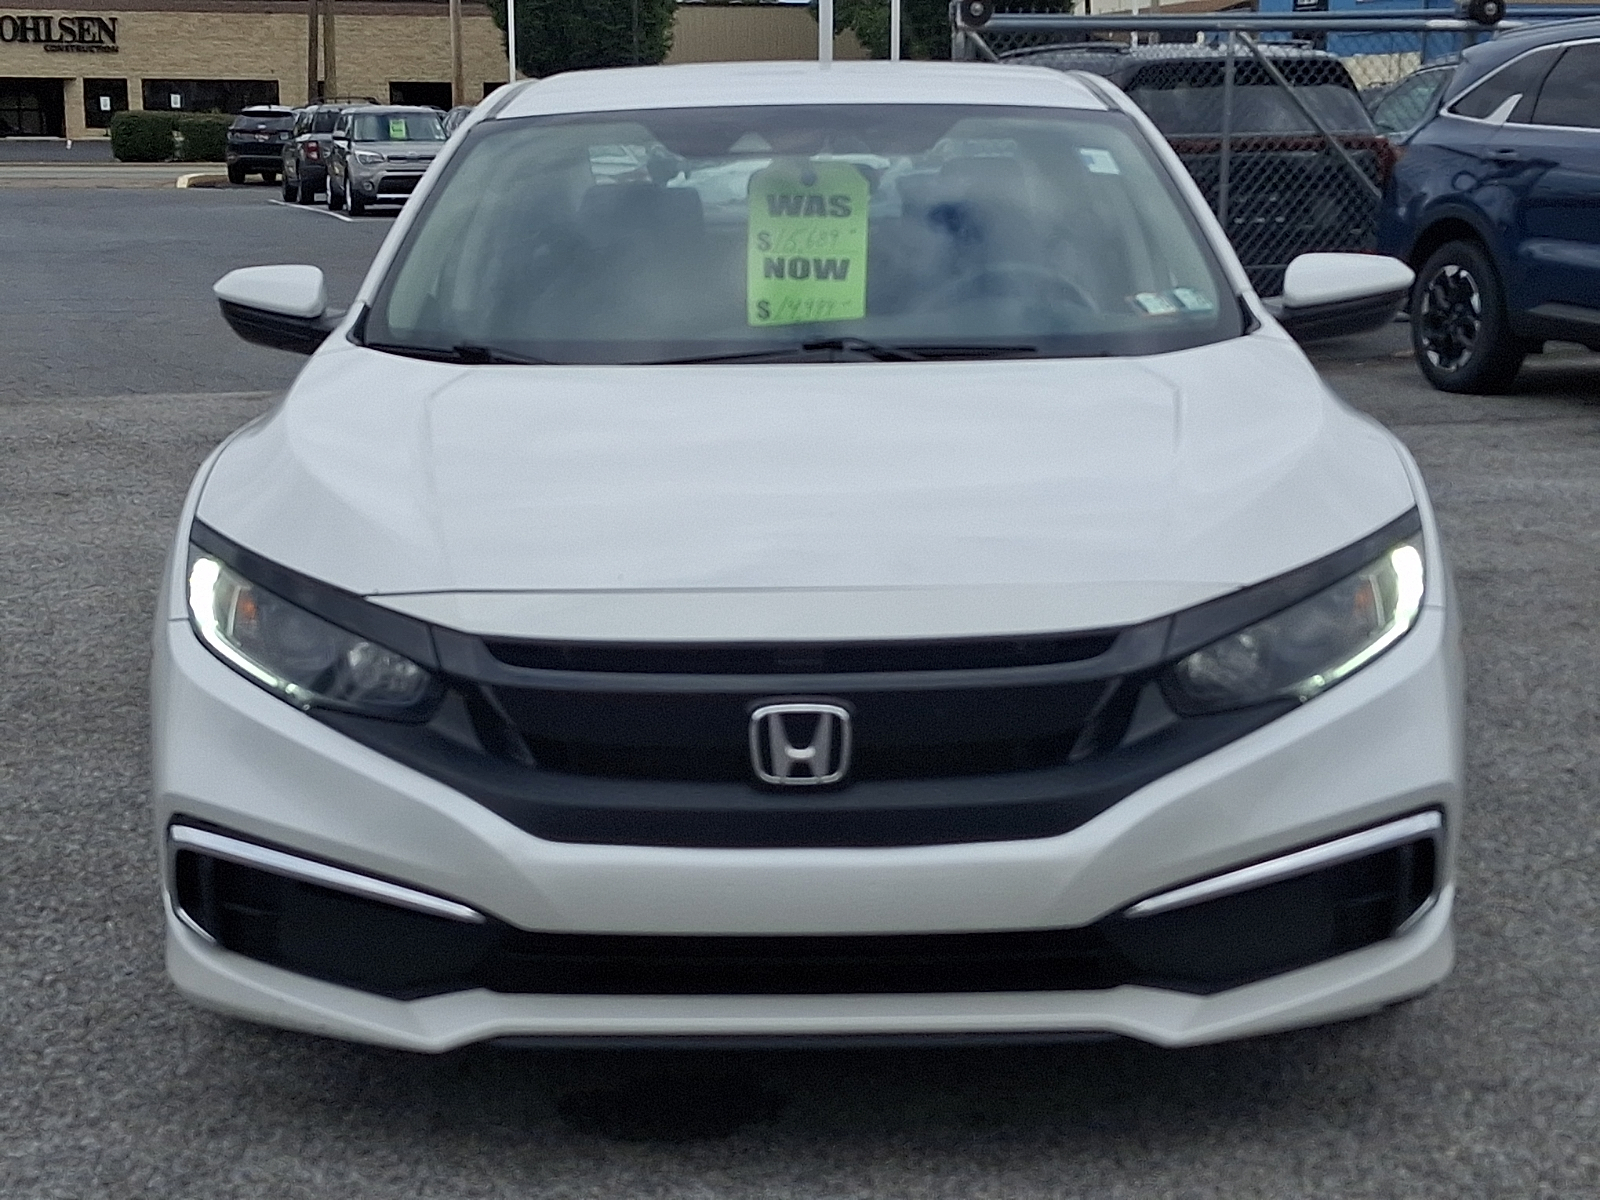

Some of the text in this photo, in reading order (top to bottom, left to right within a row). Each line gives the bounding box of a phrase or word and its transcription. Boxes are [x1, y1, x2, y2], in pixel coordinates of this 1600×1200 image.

[0, 15, 118, 43] OHLSEN
[43, 44, 119, 53] CONSTRUCTION
[767, 195, 852, 217] WAS
[764, 257, 850, 281] NOW
